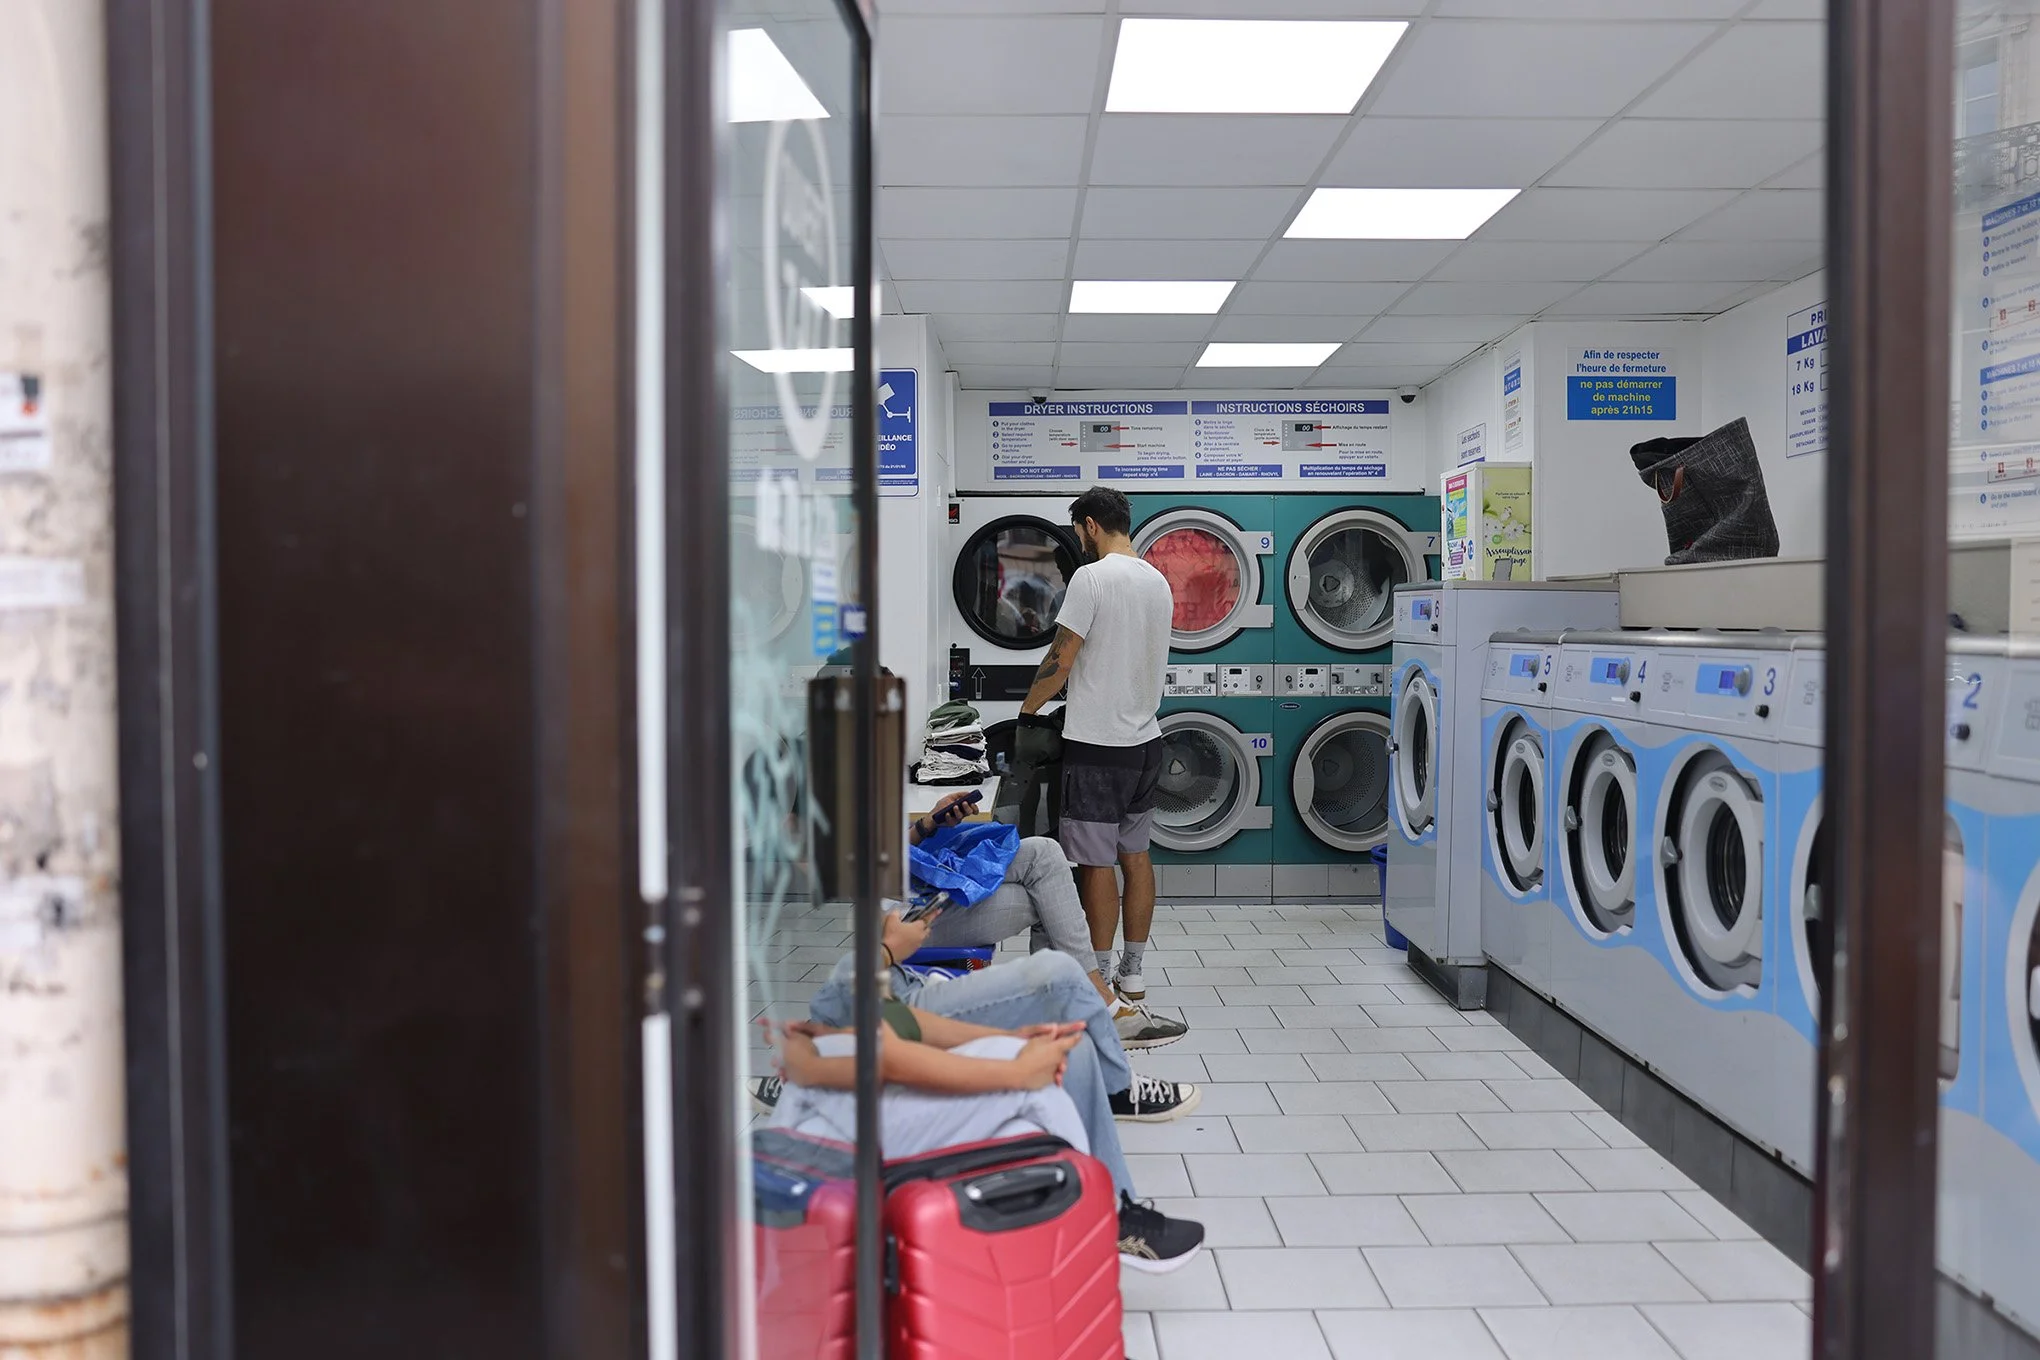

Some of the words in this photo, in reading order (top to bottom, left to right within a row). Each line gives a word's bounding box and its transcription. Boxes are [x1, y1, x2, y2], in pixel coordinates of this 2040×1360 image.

[1584, 350, 1600, 359] Afin
[1604, 350, 1614, 359] de
[1617, 351, 1660, 361] respecter
[1577, 364, 1606, 372] l'heure
[1610, 364, 1620, 372] de
[1623, 364, 1666, 372] fermeture
[1797, 361, 1800, 371] 7
[1804, 357, 1814, 369] Kg
[1596, 381, 1613, 390] pas
[1617, 380, 1662, 388] démarrer
[1792, 384, 1800, 395] 18
[1804, 381, 1814, 392] Kg
[1593, 392, 1605, 401] de
[1608, 392, 1650, 401] machine
[1024, 404, 1064, 414] DRYER
[1067, 404, 1153, 414] INSTRUCTIONS
[1216, 403, 1302, 413] INSTRUCTIONS
[1305, 401, 1364, 412] SÉCHOIRS
[1591, 405, 1619, 416] après
[1622, 405, 1652, 414] 21h15
[1260, 537, 1269, 548] 9
[1427, 536, 1435, 548] 7
[1486, 546, 1532, 557] Assouplissan
[1435, 600, 1440, 618] 6
[1544, 654, 1552, 676] 5
[1638, 660, 1647, 684] 4
[1764, 668, 1776, 696] 3
[1962, 672, 1982, 710] 2
[1251, 738, 1267, 748] 10
